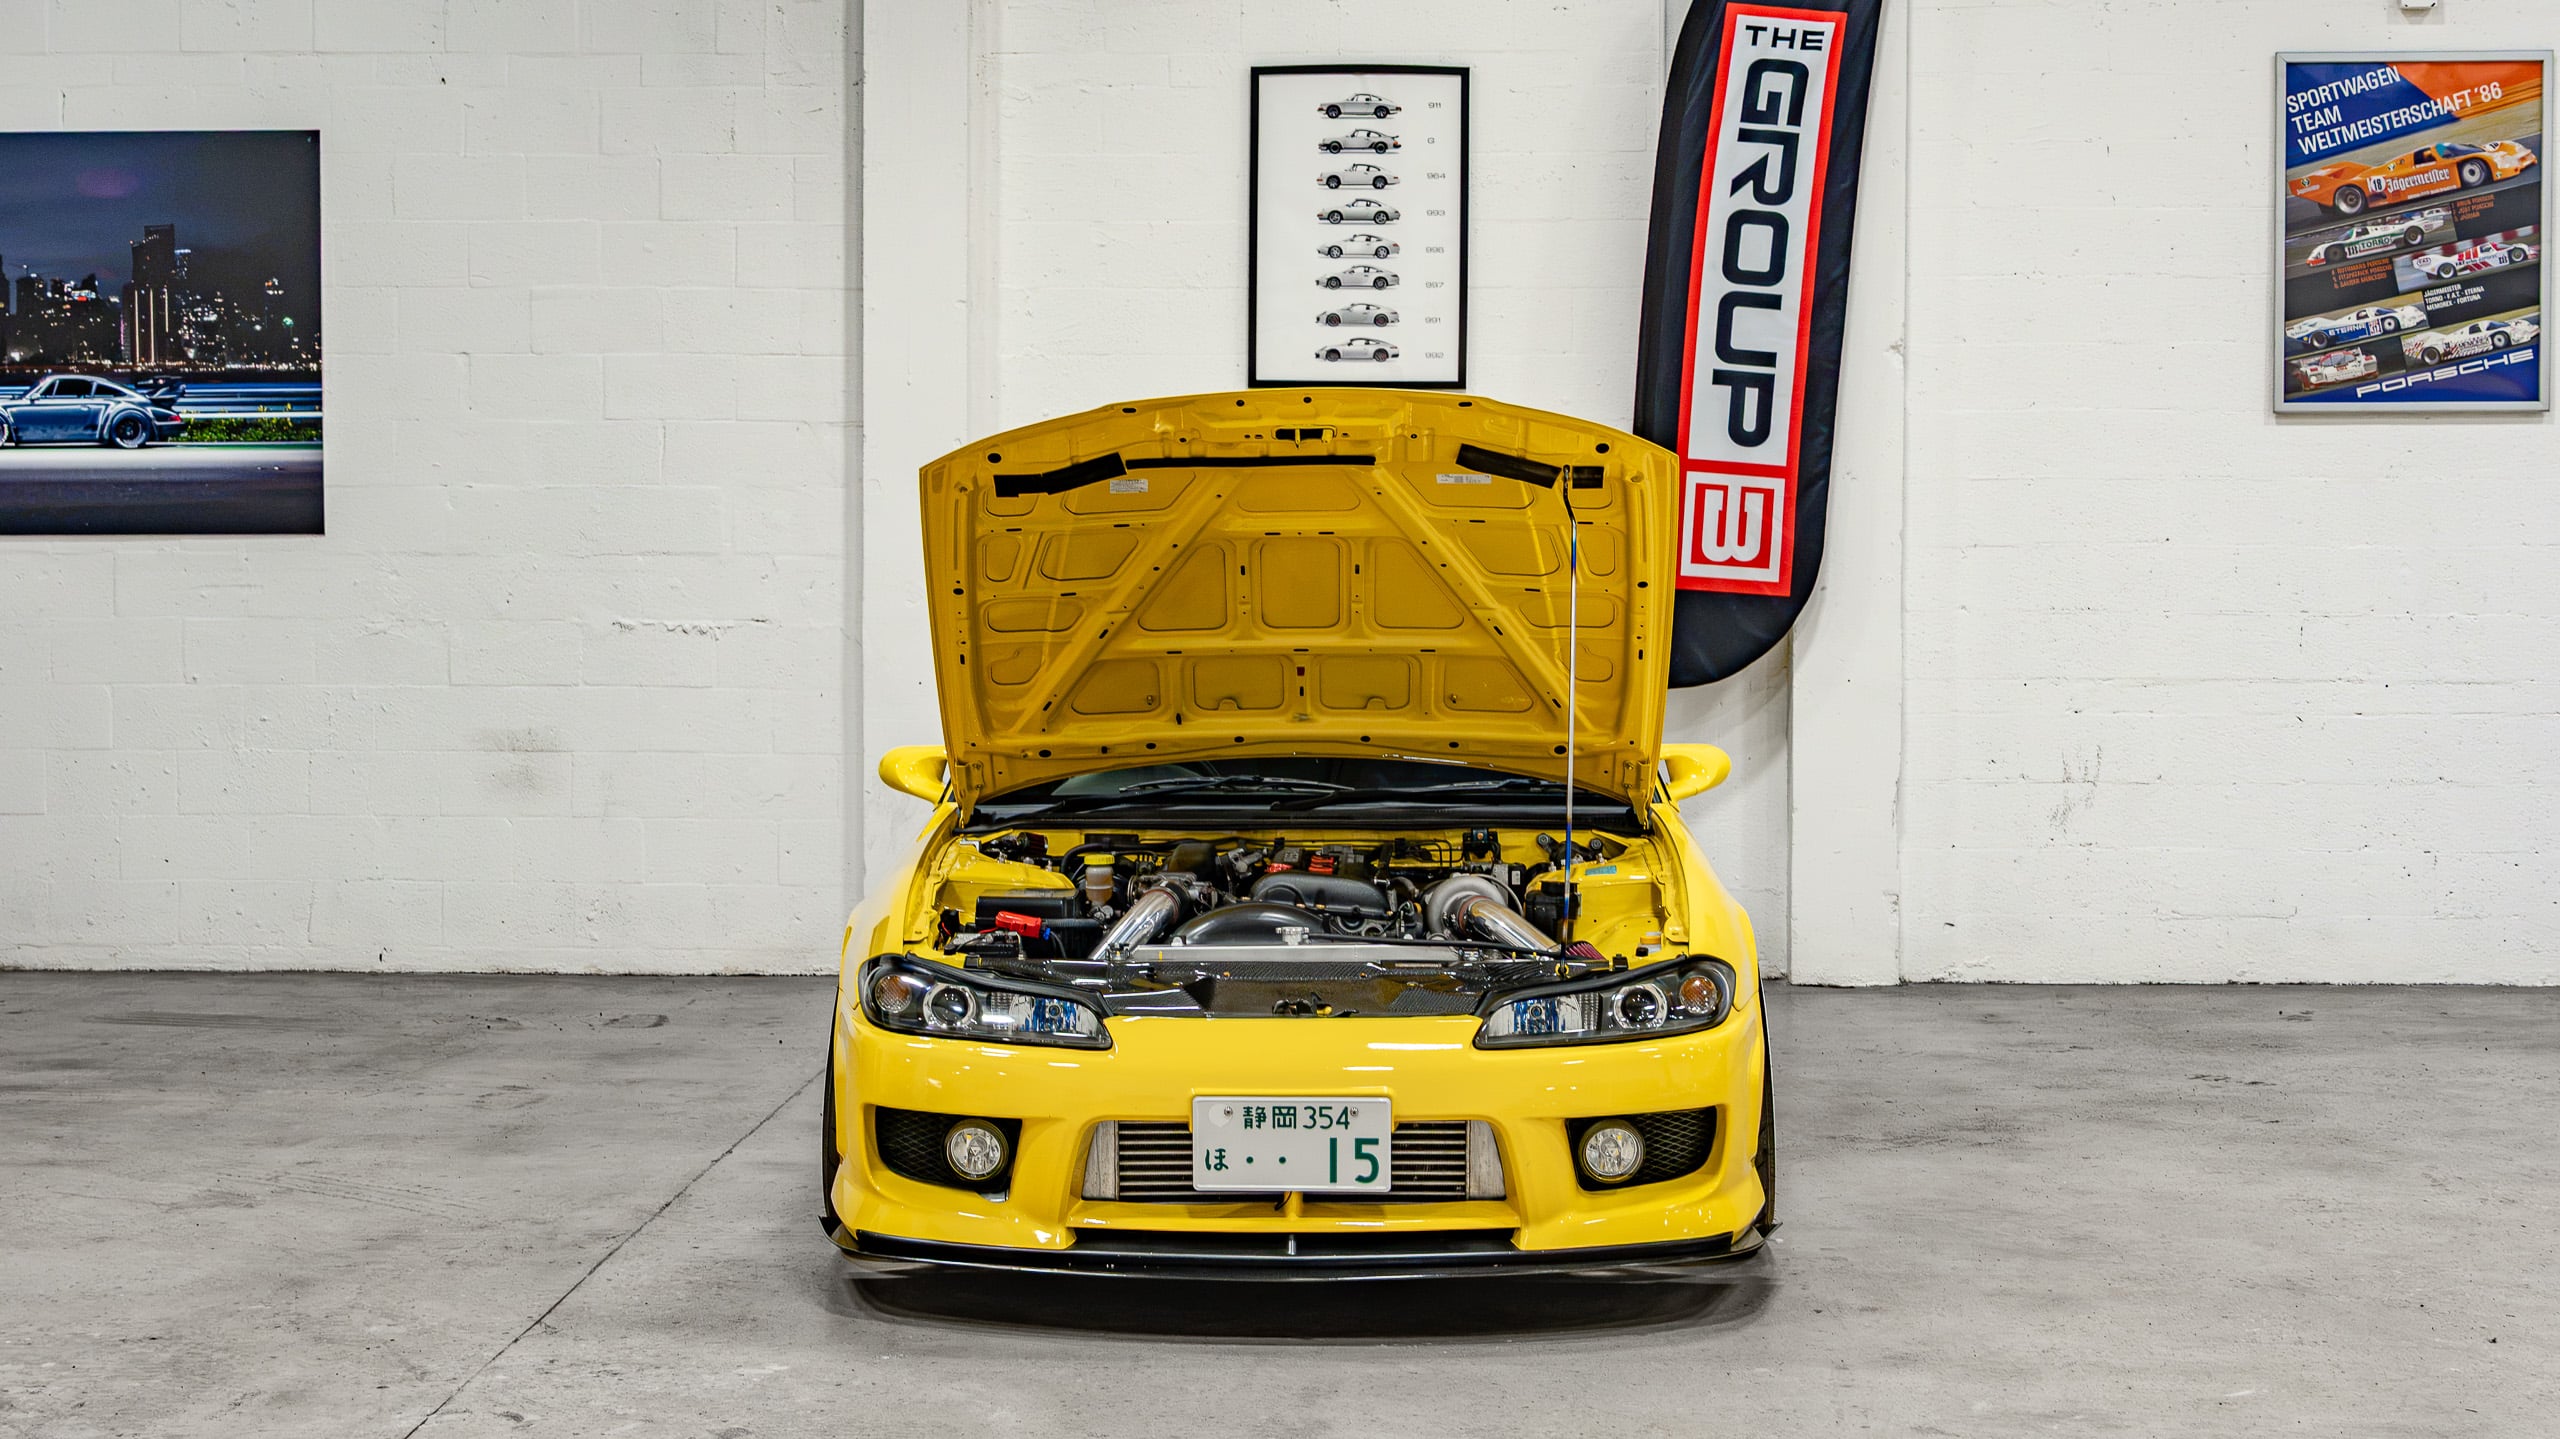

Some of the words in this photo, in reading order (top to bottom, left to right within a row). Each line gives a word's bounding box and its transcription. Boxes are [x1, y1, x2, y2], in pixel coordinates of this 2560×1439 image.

[1745, 25, 1825, 51] THE
[2287, 65, 2401, 113] SPORTWAGEN
[2291, 105, 2342, 134] TEAM
[2297, 89, 2472, 155] WELTMEISTERSCHAFT
[2373, 178, 2383, 191] 18
[2386, 168, 2450, 193] Jägermeister
[1712, 58, 1810, 448] GROUP
[2361, 237, 2391, 250] TORNO
[2356, 349, 2535, 398] PORSCHE
[1243, 1106, 1297, 1129] 静岡
[1302, 1106, 1350, 1130] 354
[1204, 1148, 1229, 1171] ほ
[1329, 1137, 1380, 1184] 15
